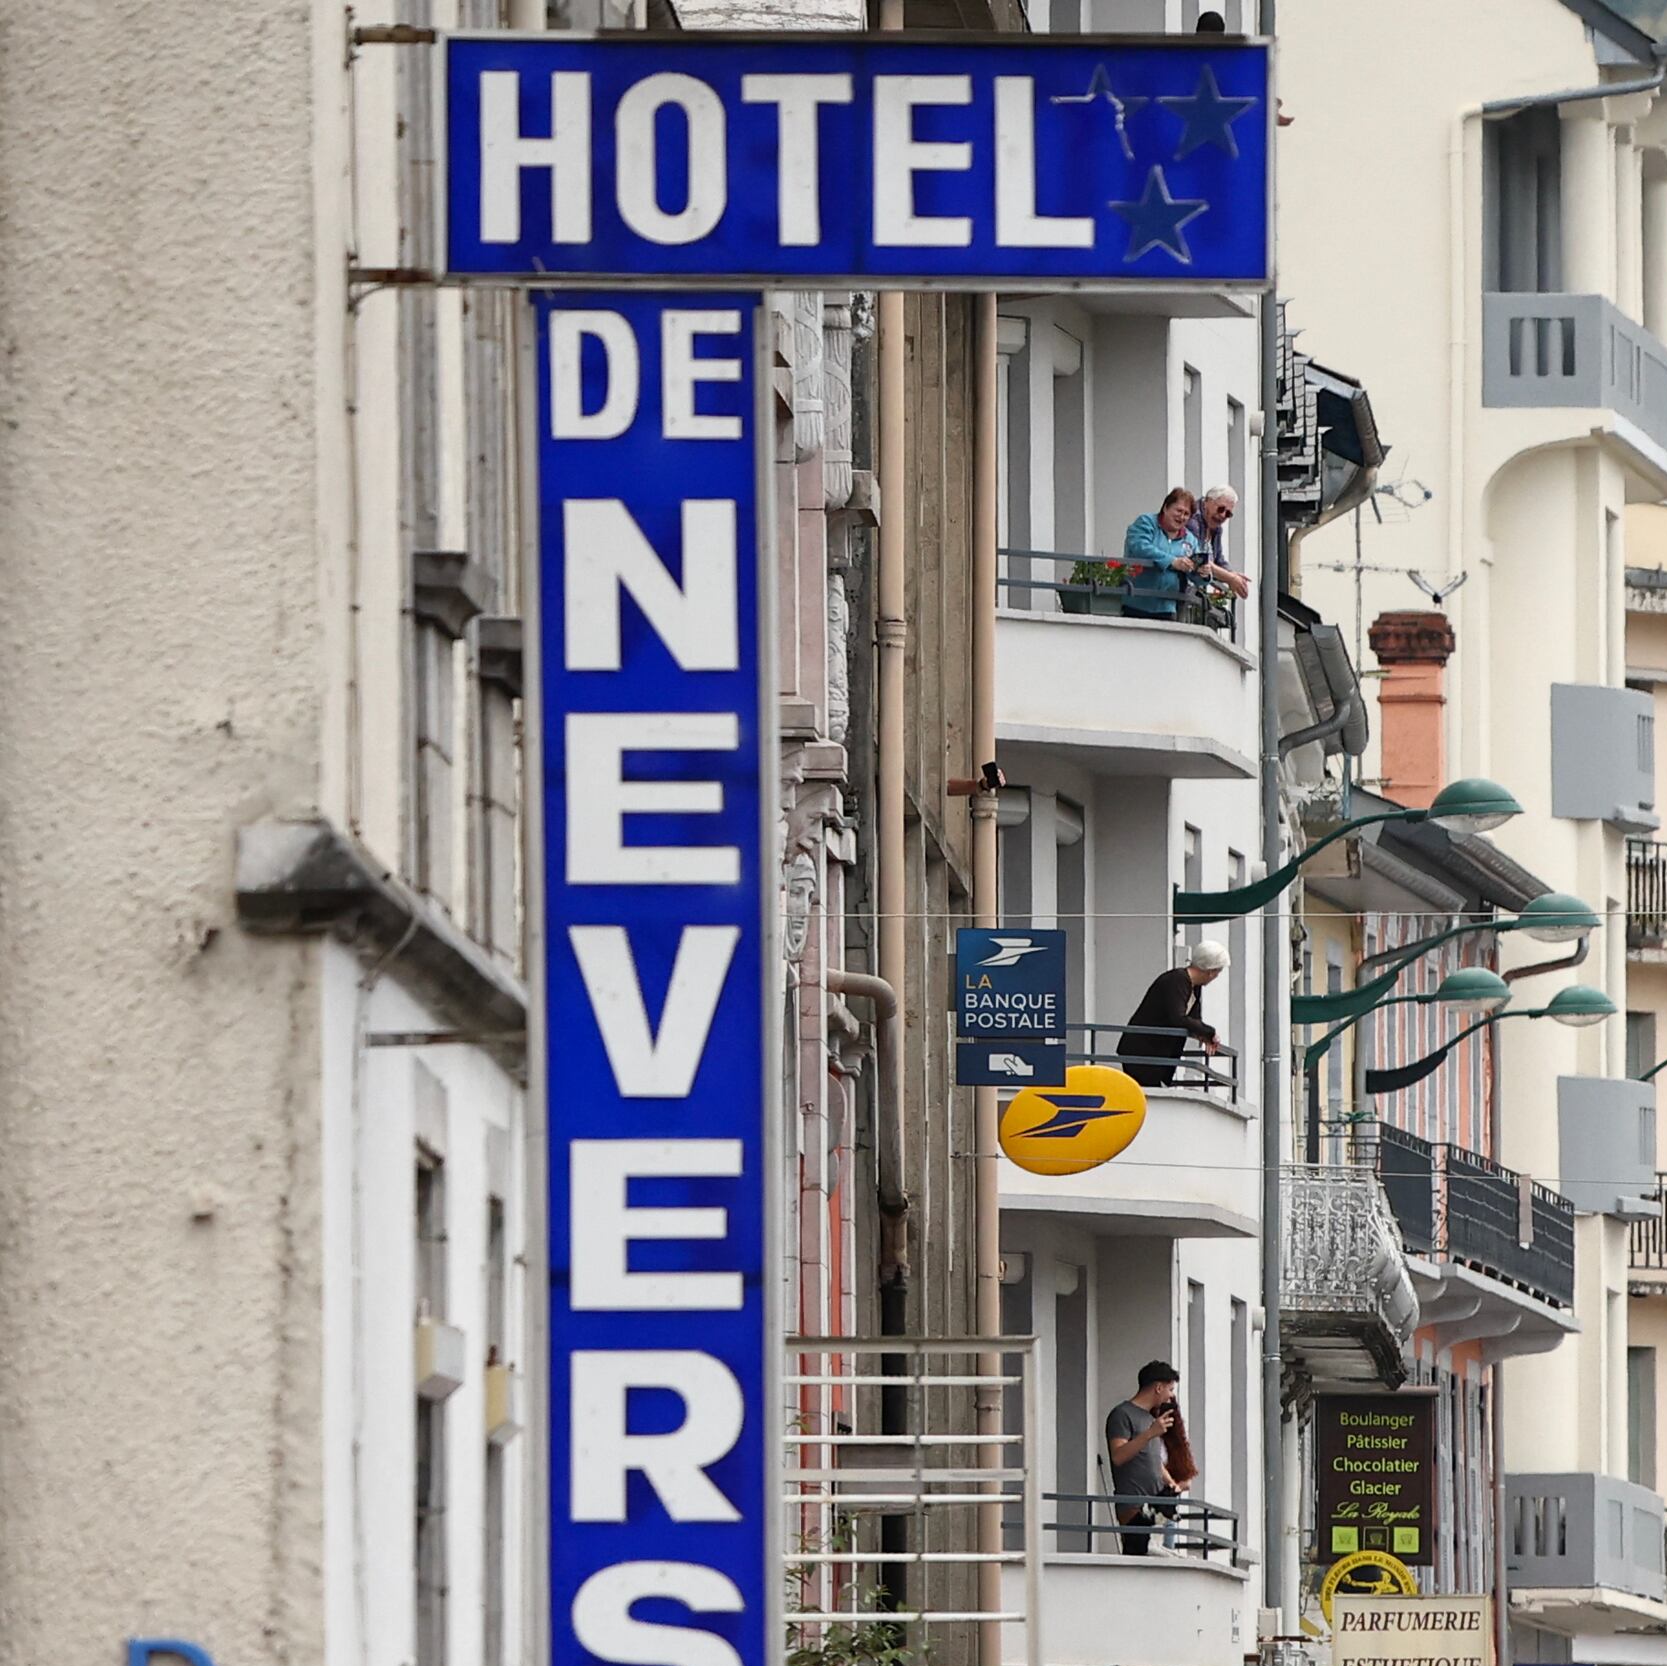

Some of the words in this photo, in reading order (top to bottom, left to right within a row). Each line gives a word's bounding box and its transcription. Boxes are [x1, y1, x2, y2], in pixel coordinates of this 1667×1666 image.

[477, 70, 1096, 249] HOTEL
[549, 308, 743, 441] DE
[965, 974, 993, 989] LA
[965, 993, 1056, 1011] BANQUE
[965, 1012, 1056, 1029] POSTALE
[1340, 1412, 1415, 1430] Boulanger
[1347, 1434, 1408, 1449] Pâtissier
[1333, 1457, 1419, 1473] Chocolatier
[1350, 1480, 1402, 1496] Glacier
[1340, 1611, 1481, 1632] PARFUMERIE
